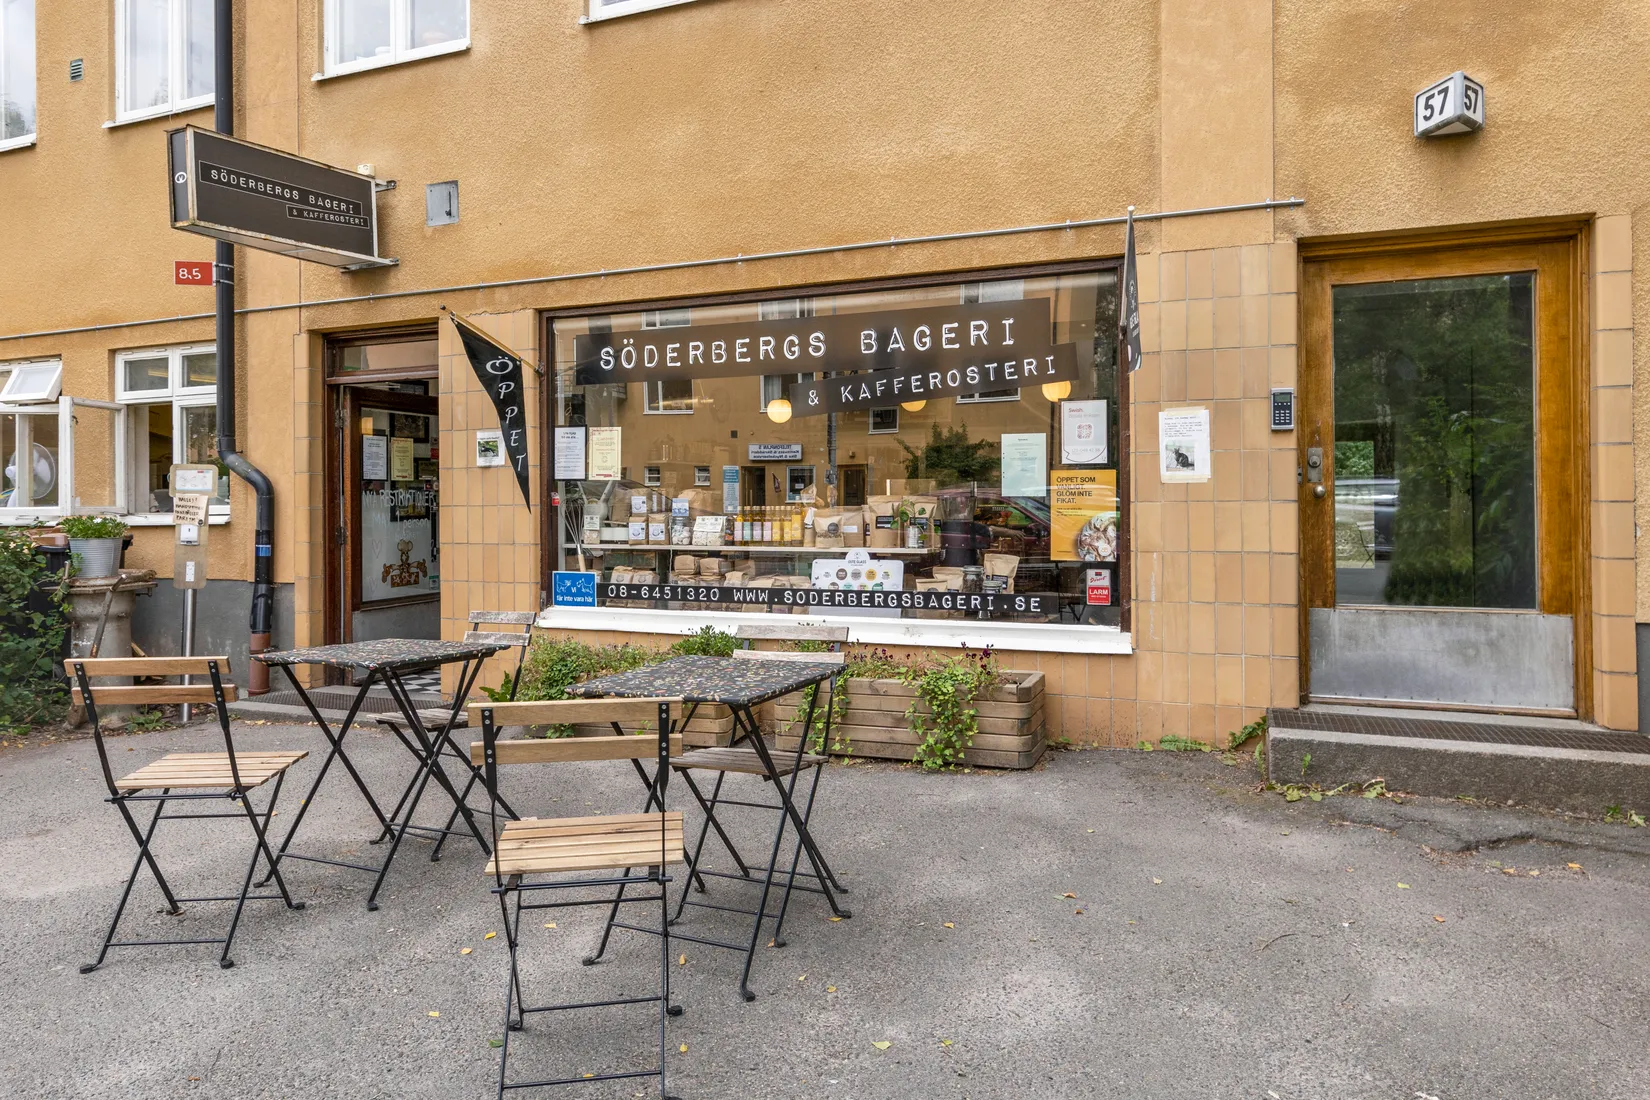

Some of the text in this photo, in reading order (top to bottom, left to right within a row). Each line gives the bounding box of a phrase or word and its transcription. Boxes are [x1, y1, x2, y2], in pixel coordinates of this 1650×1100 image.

[1423, 85, 1449, 121] 57
[1464, 84, 1479, 114] 57
[210, 169, 354, 214] SÖDERBERGS BAGERI
[303, 210, 365, 226] KAFFEROSTERI
[178, 268, 202, 280] 8,5
[600, 318, 1015, 370] SÖDERBERGS BAGERI
[808, 355, 1056, 406] & KAFFEROSTERI
[485, 355, 526, 472] ÖPPET
[607, 585, 720, 601] 08-6451320
